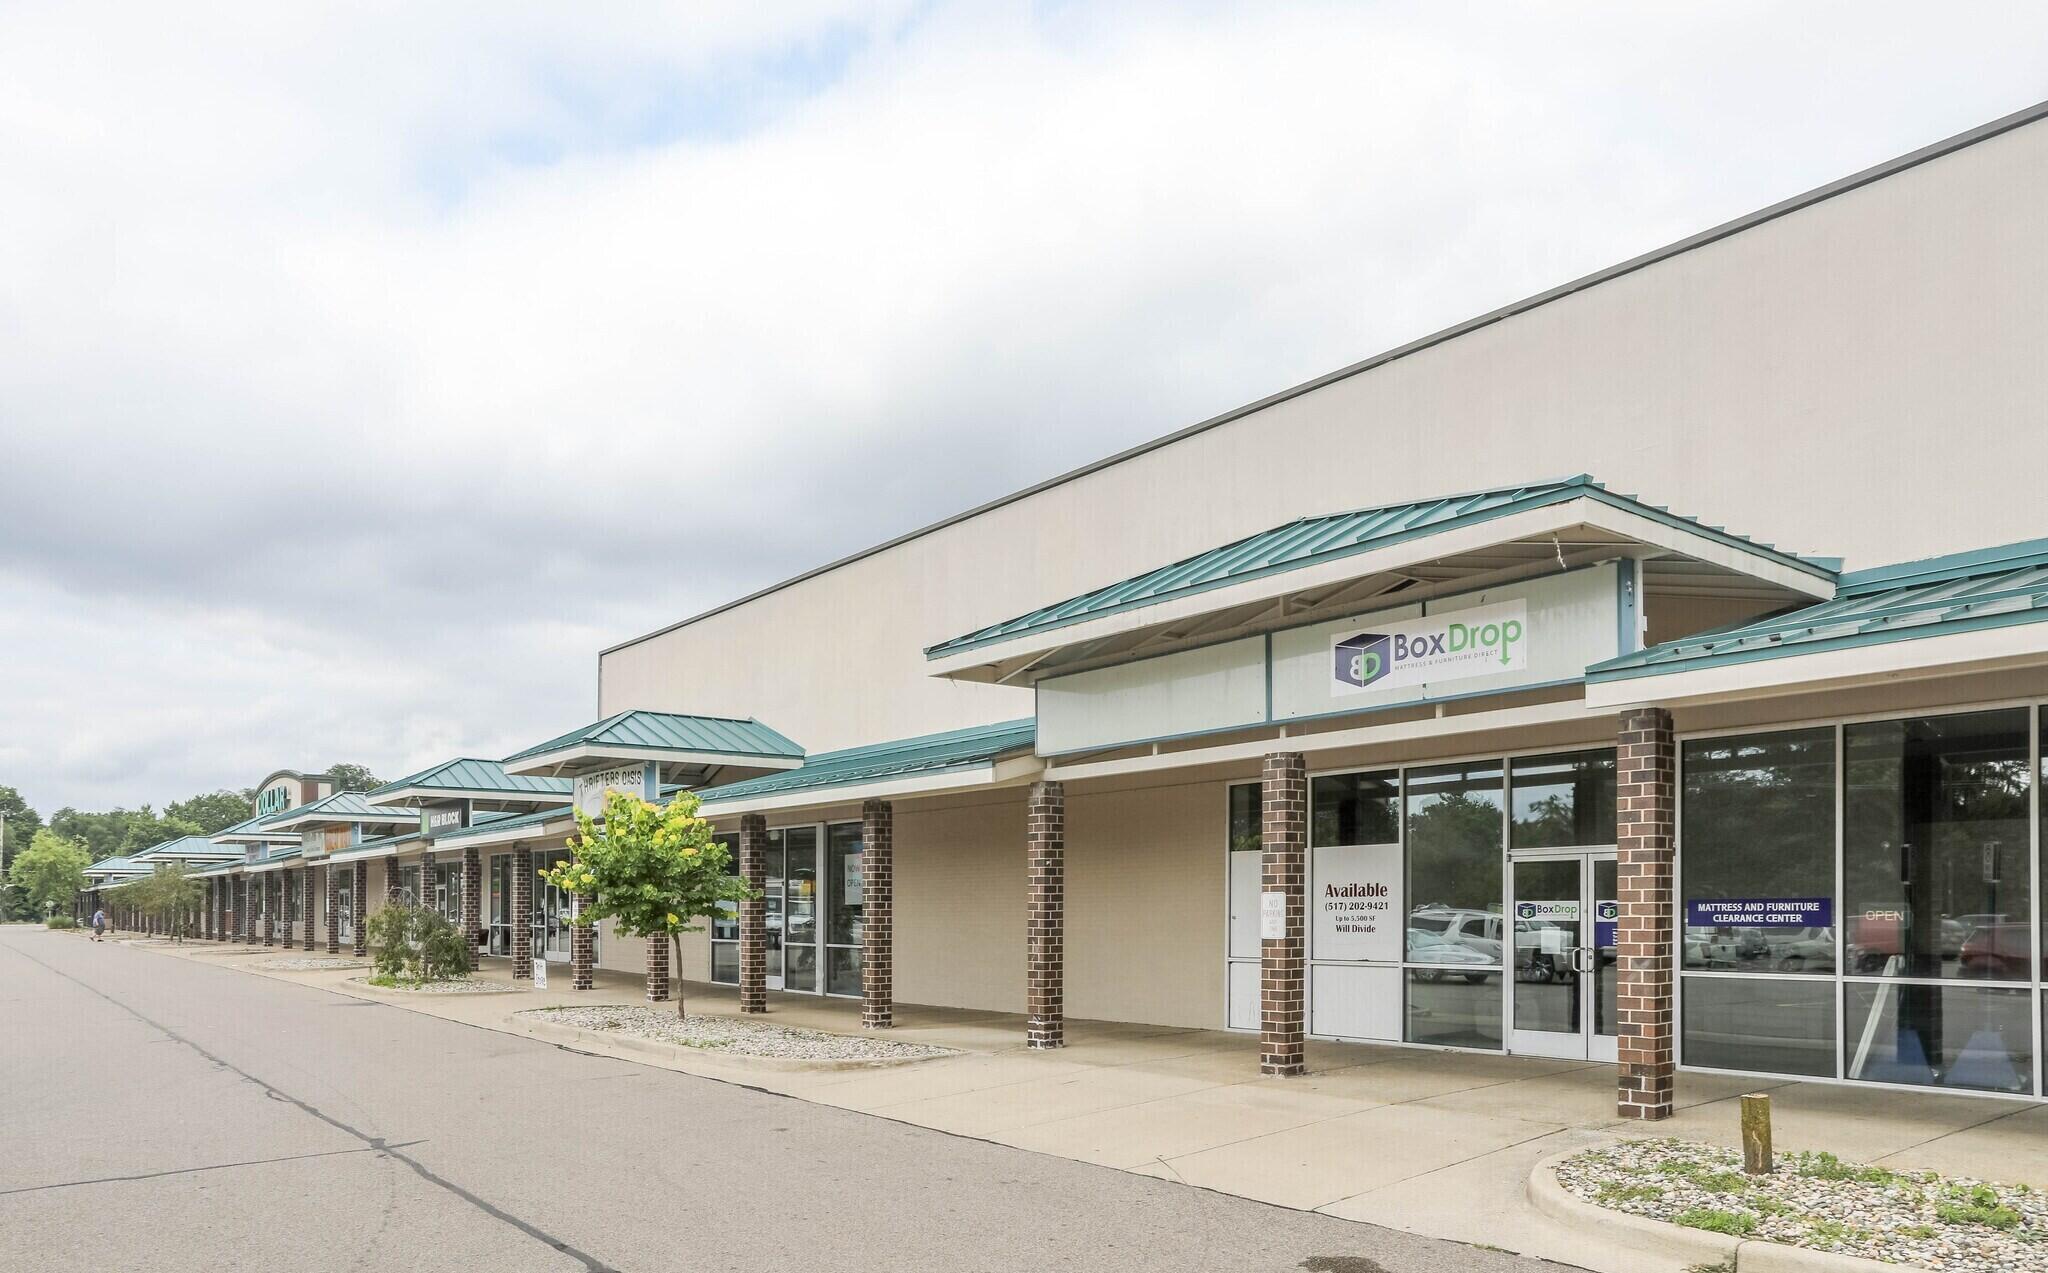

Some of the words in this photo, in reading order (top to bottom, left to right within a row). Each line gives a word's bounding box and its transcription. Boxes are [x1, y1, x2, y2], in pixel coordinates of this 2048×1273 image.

[1395, 619, 1523, 665] BoxDrop
[1395, 660, 1427, 671] MATTRESS
[1434, 653, 1472, 665] FURNITURE
[1473, 649, 1499, 659] DIRECT
[621, 770, 642, 785] OASIS
[258, 785, 287, 816] DOLLAR
[441, 810, 460, 826] BLOCK
[1325, 882, 1388, 897] Available
[1268, 899, 1279, 908] NO
[1325, 902, 1347, 911] (517)
[1349, 902, 1389, 910] 202-9421
[1698, 903, 1742, 911] MATTRESS
[1744, 903, 1764, 911] AND
[1766, 902, 1820, 911] FURNITURE
[1537, 904, 1577, 918] BoxDrop
[1713, 914, 1763, 922] CLEARANCE
[1766, 914, 1803, 922] CENTER
[1866, 911, 1904, 920] OPEN
[1336, 924, 1350, 932] Will
[1352, 924, 1376, 933] Divide
